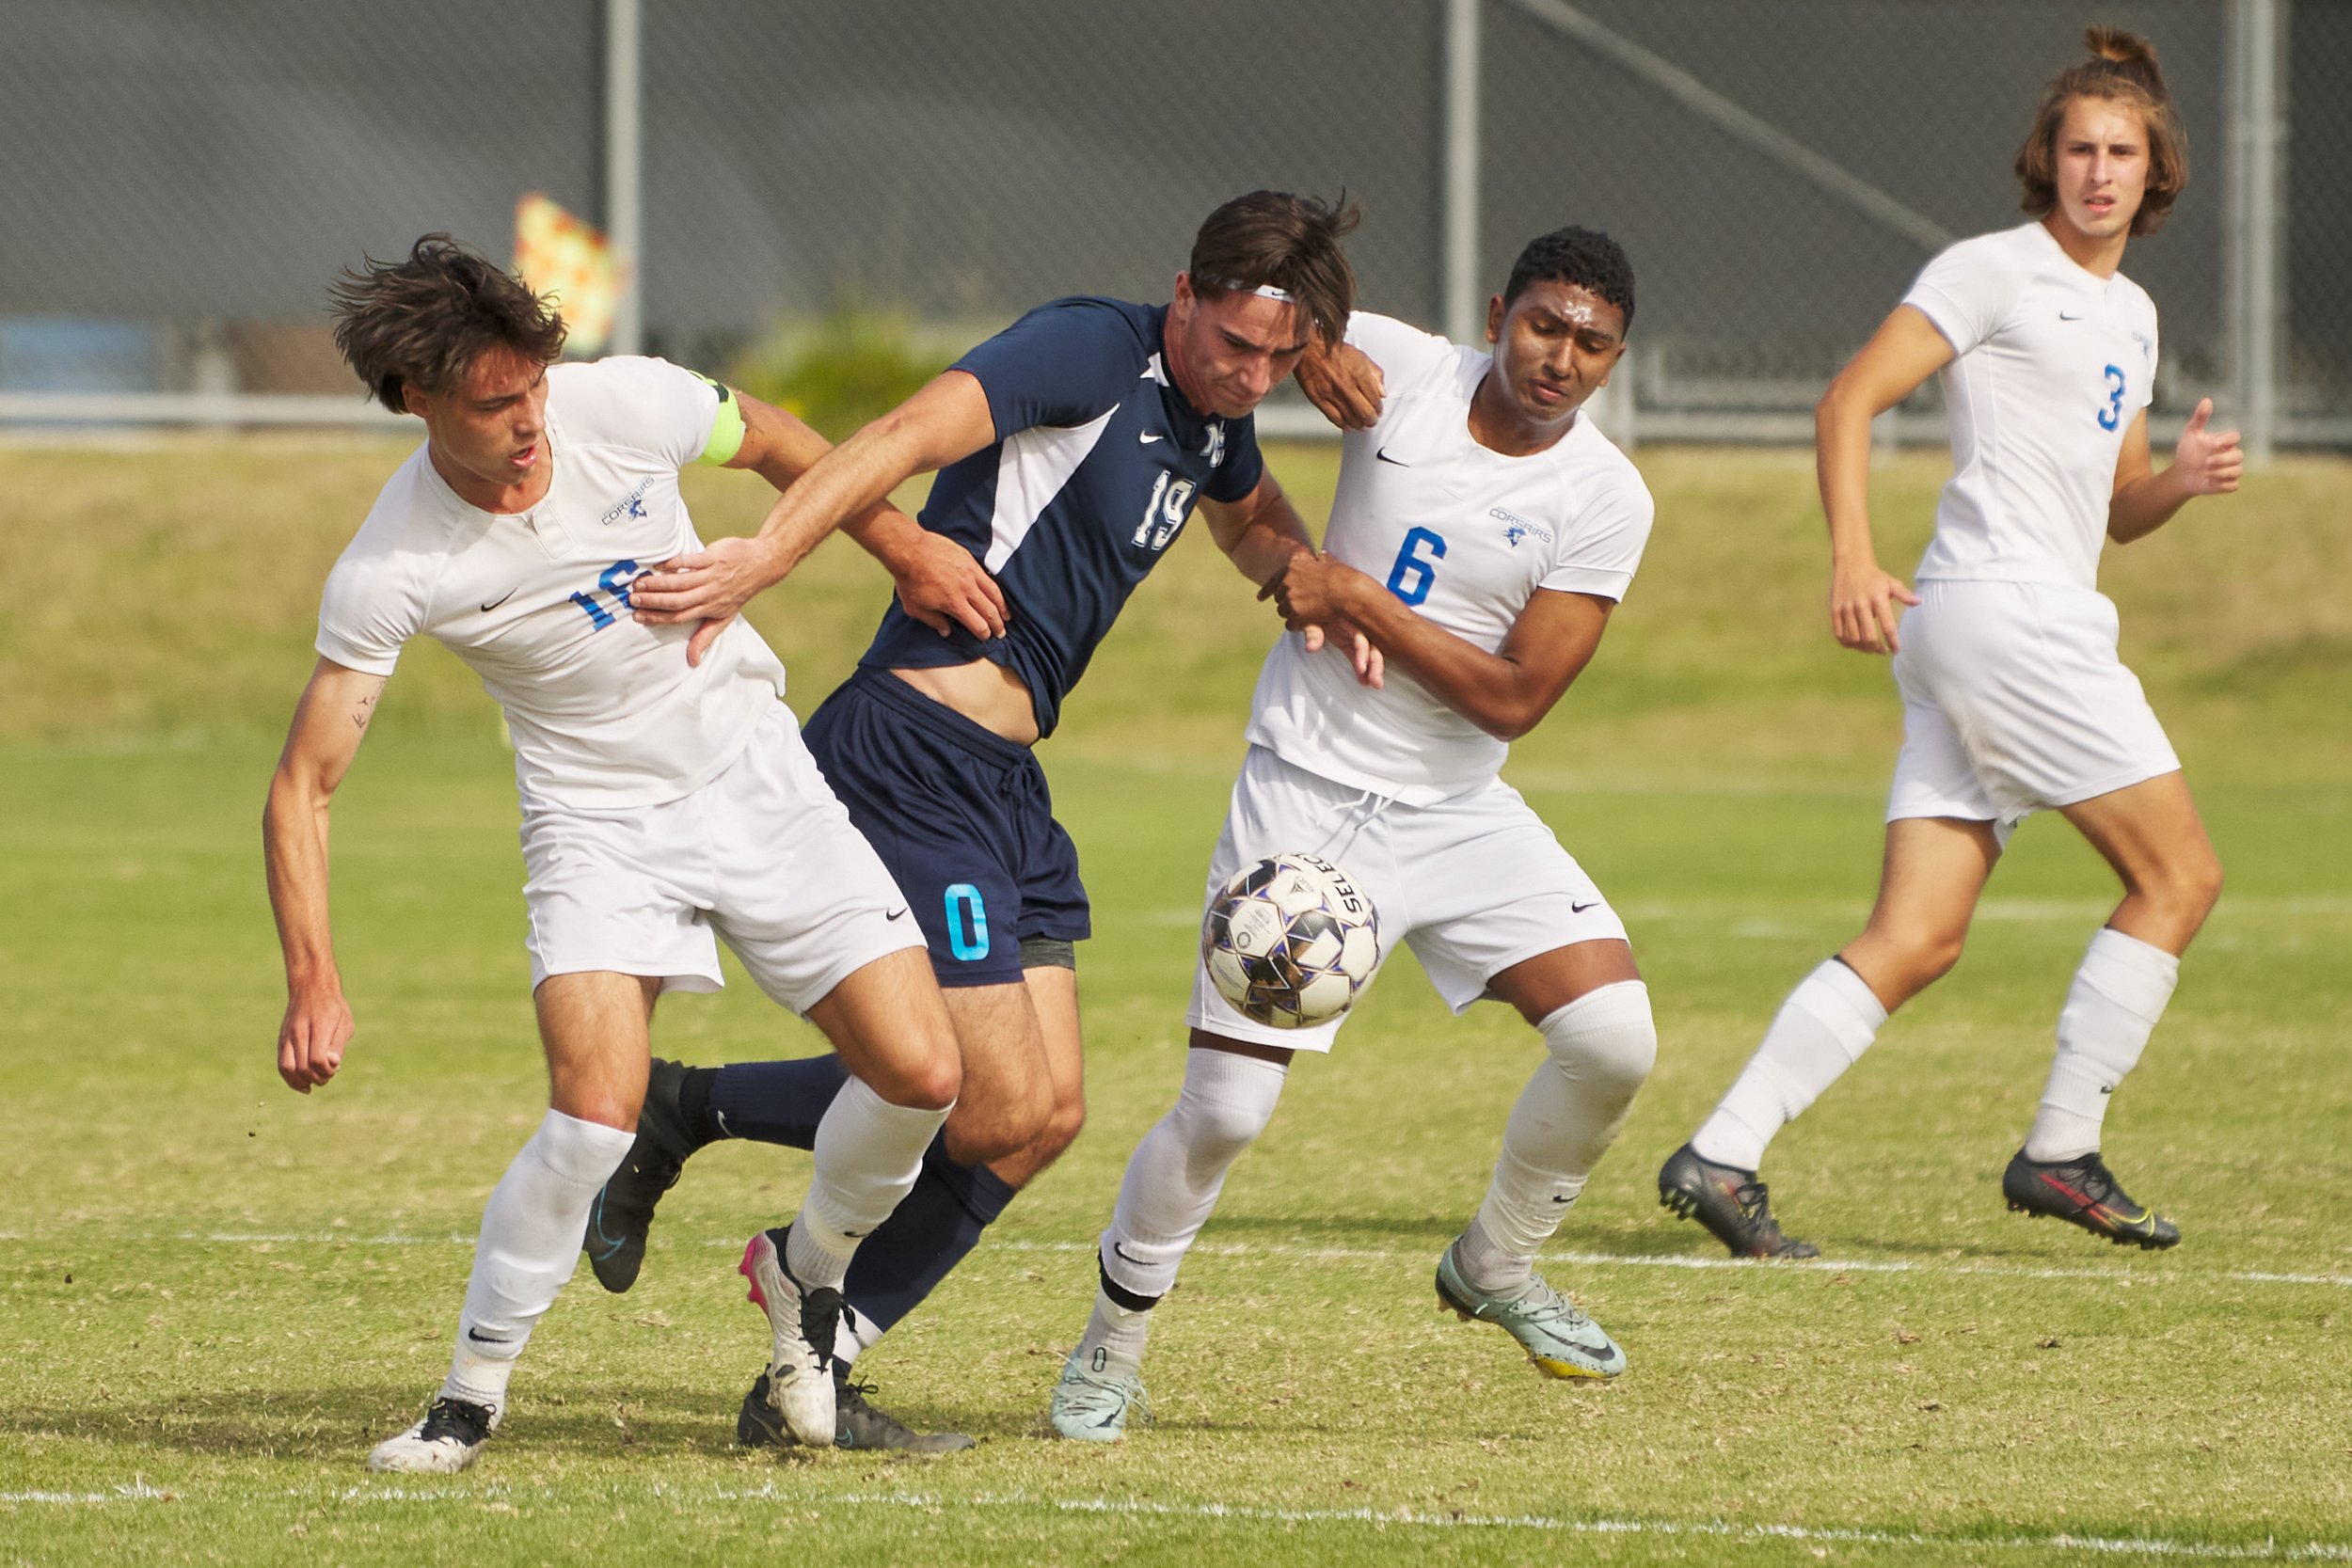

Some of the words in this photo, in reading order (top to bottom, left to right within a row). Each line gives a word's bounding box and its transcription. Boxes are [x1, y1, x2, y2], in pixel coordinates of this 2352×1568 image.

[2097, 363, 2125, 433] 3
[601, 476, 655, 526] CORSAIRS
[1131, 469, 1197, 550] 19
[1489, 507, 1552, 544] CORSAIRS
[1387, 526, 1447, 607] 6
[945, 883, 990, 961] 0
